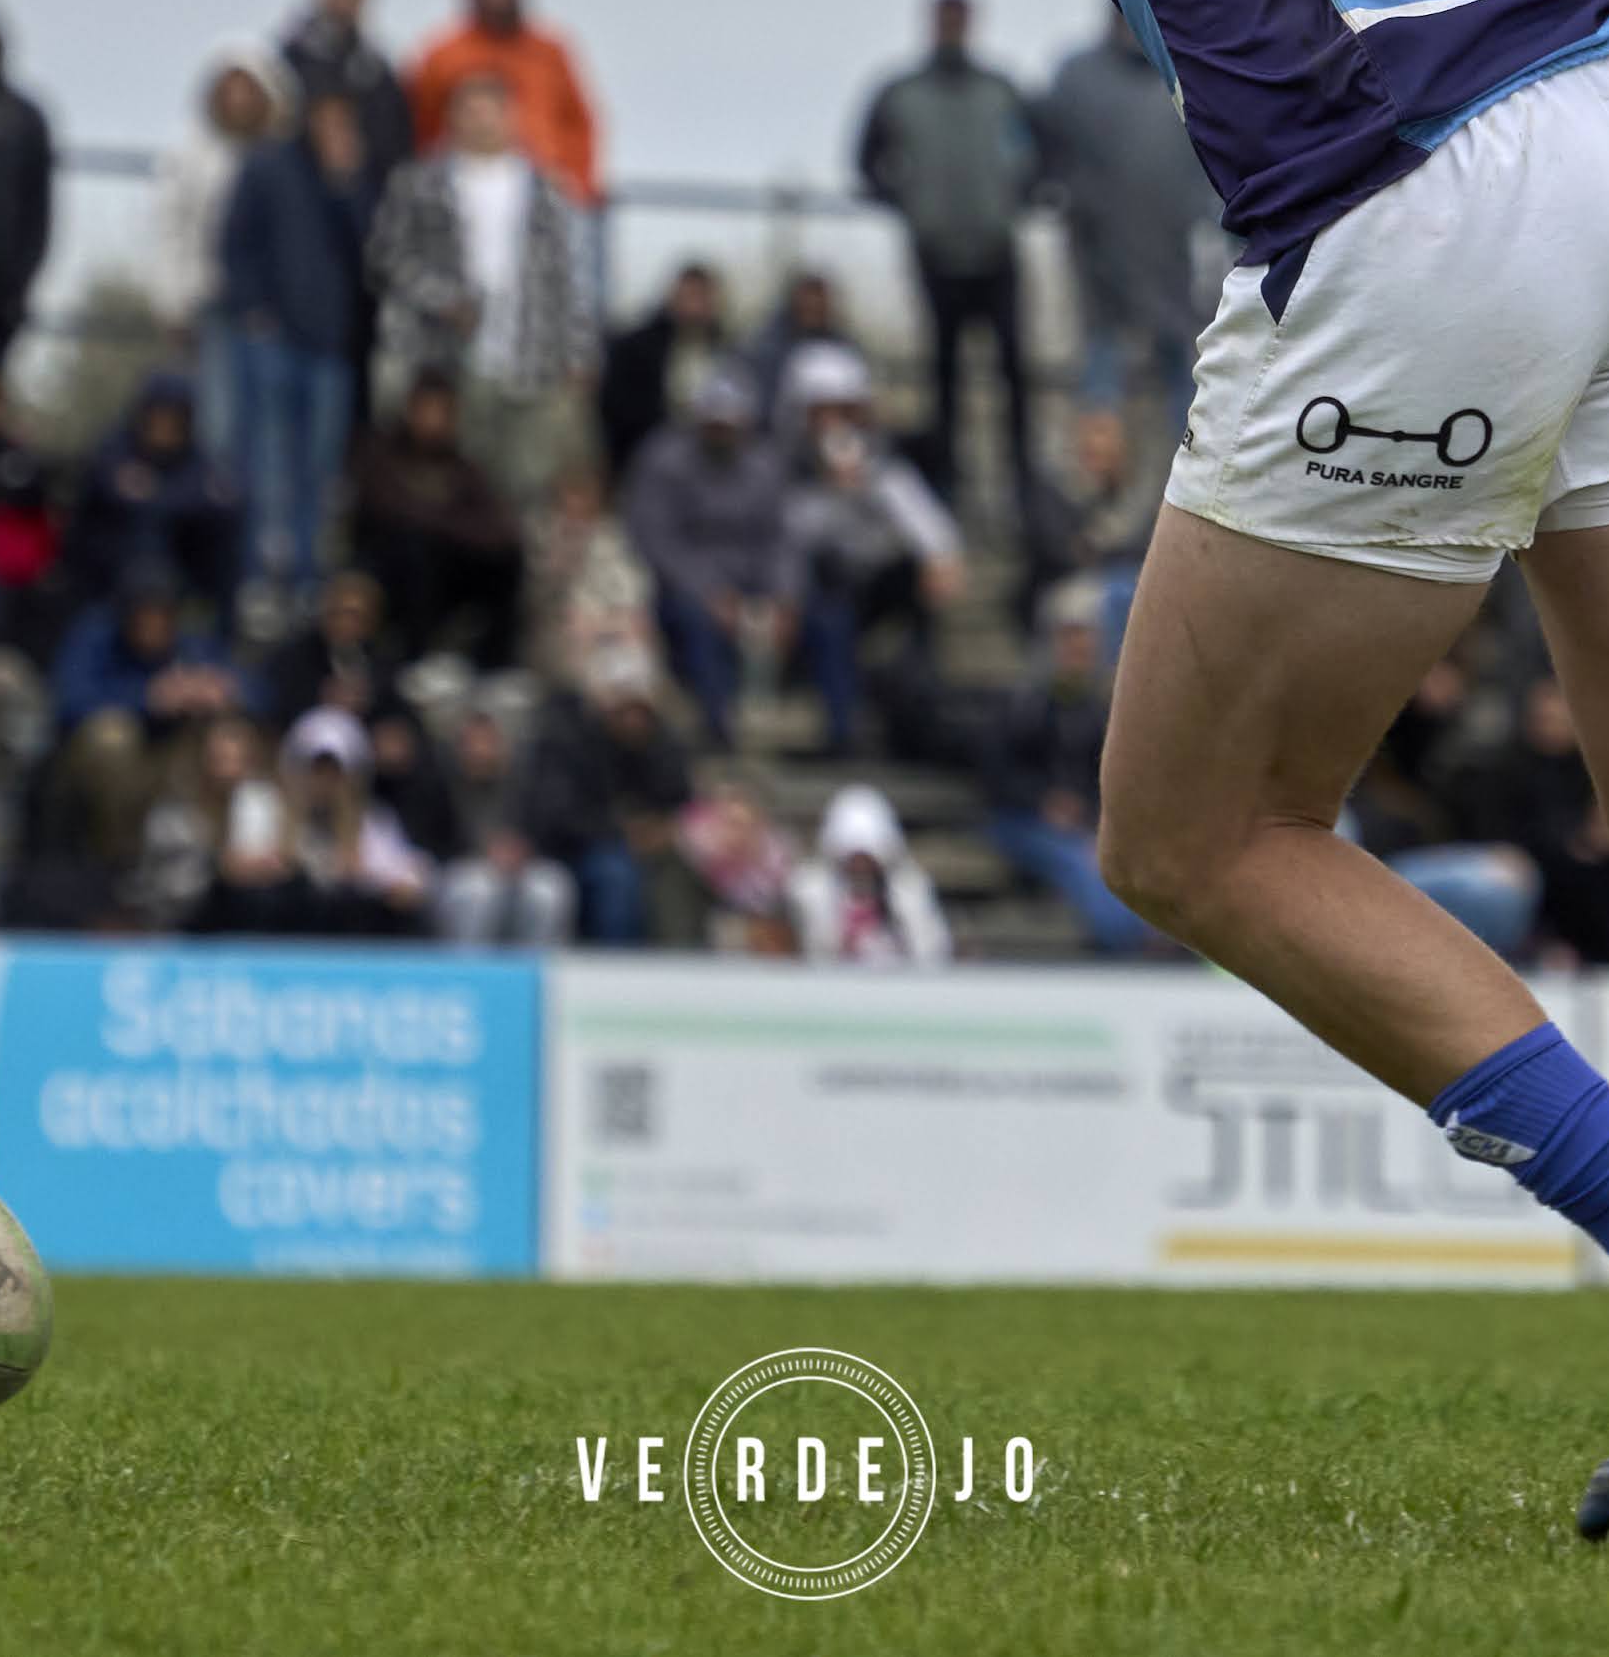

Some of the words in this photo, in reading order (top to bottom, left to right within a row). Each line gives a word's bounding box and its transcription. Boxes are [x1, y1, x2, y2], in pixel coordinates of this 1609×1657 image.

[1305, 460, 1365, 485] PURA
[1369, 471, 1464, 490] SANGRE
[216, 1156, 481, 1235] covers
